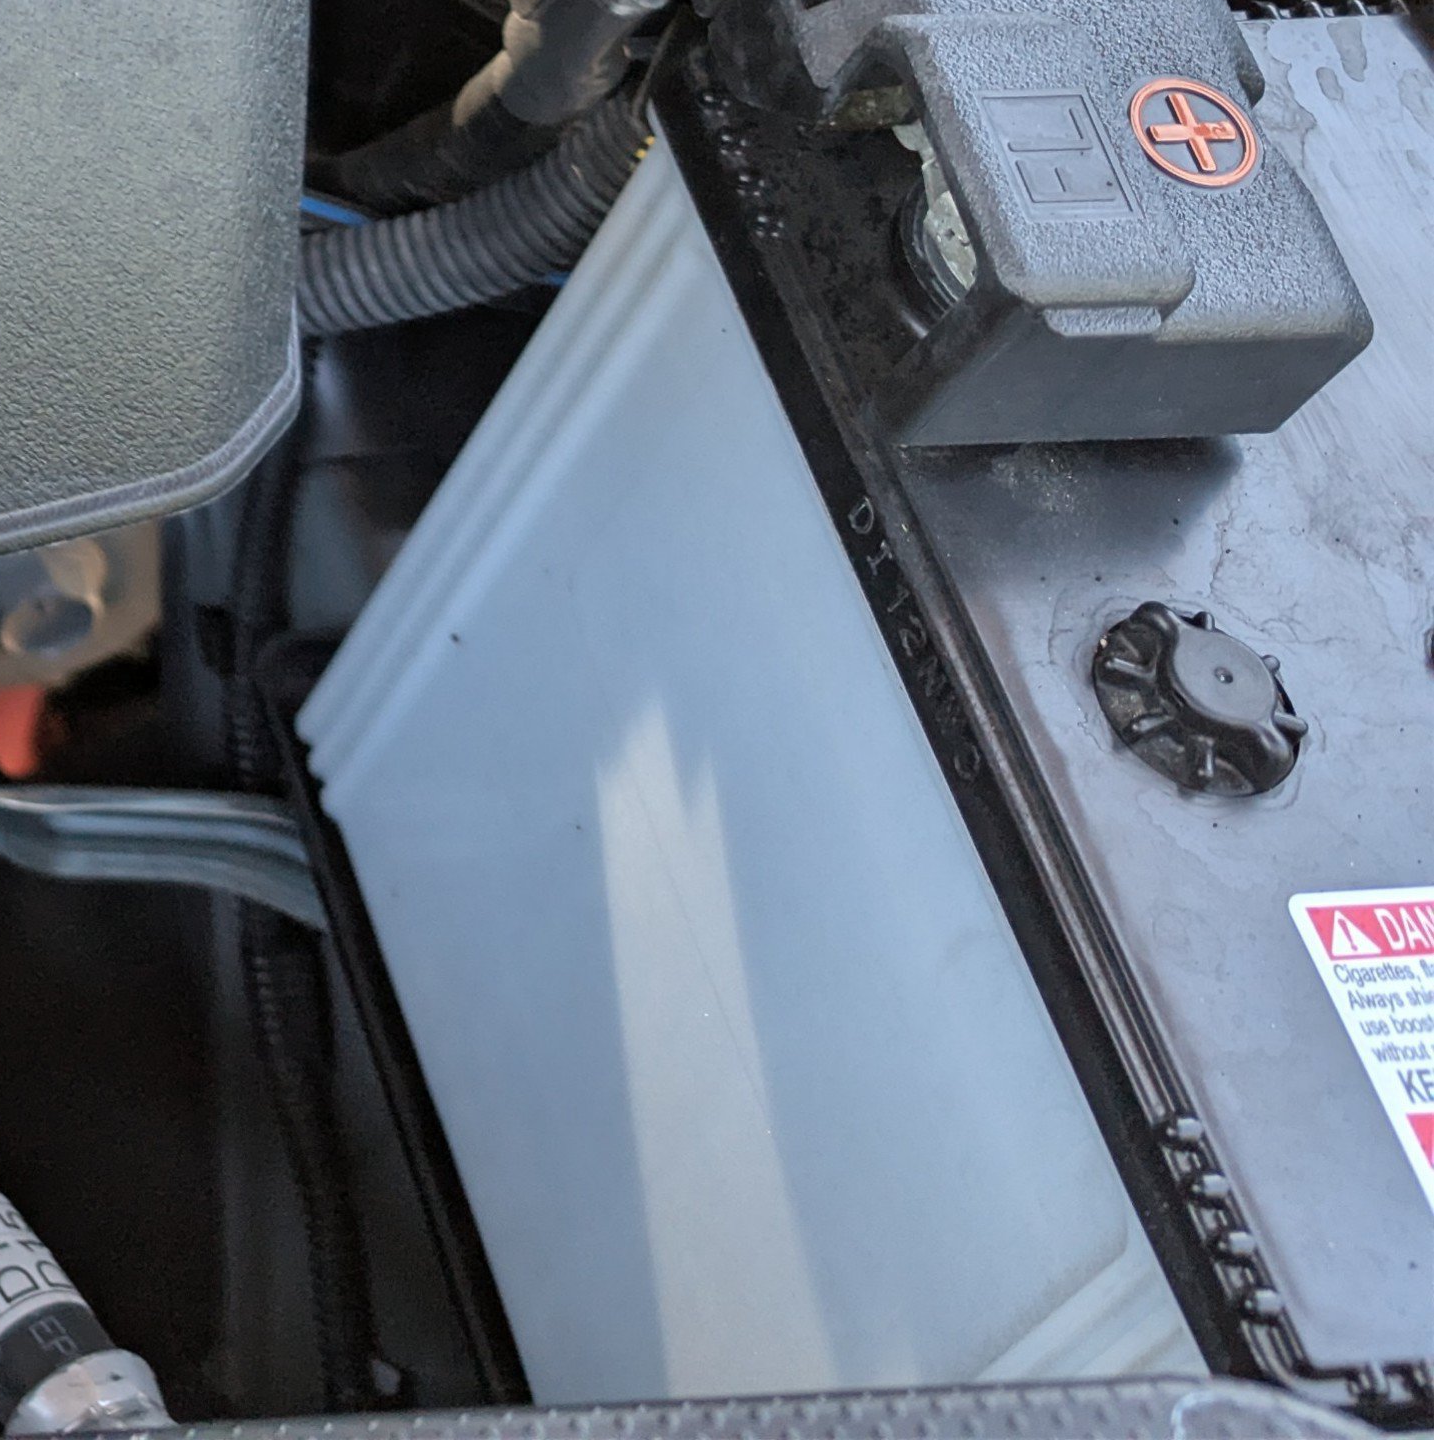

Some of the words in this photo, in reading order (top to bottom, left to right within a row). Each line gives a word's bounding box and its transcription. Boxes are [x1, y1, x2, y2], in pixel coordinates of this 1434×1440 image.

[1347, 989, 1404, 1013] Always
[1359, 1020, 1390, 1036] use
[1371, 1041, 1431, 1062] without
